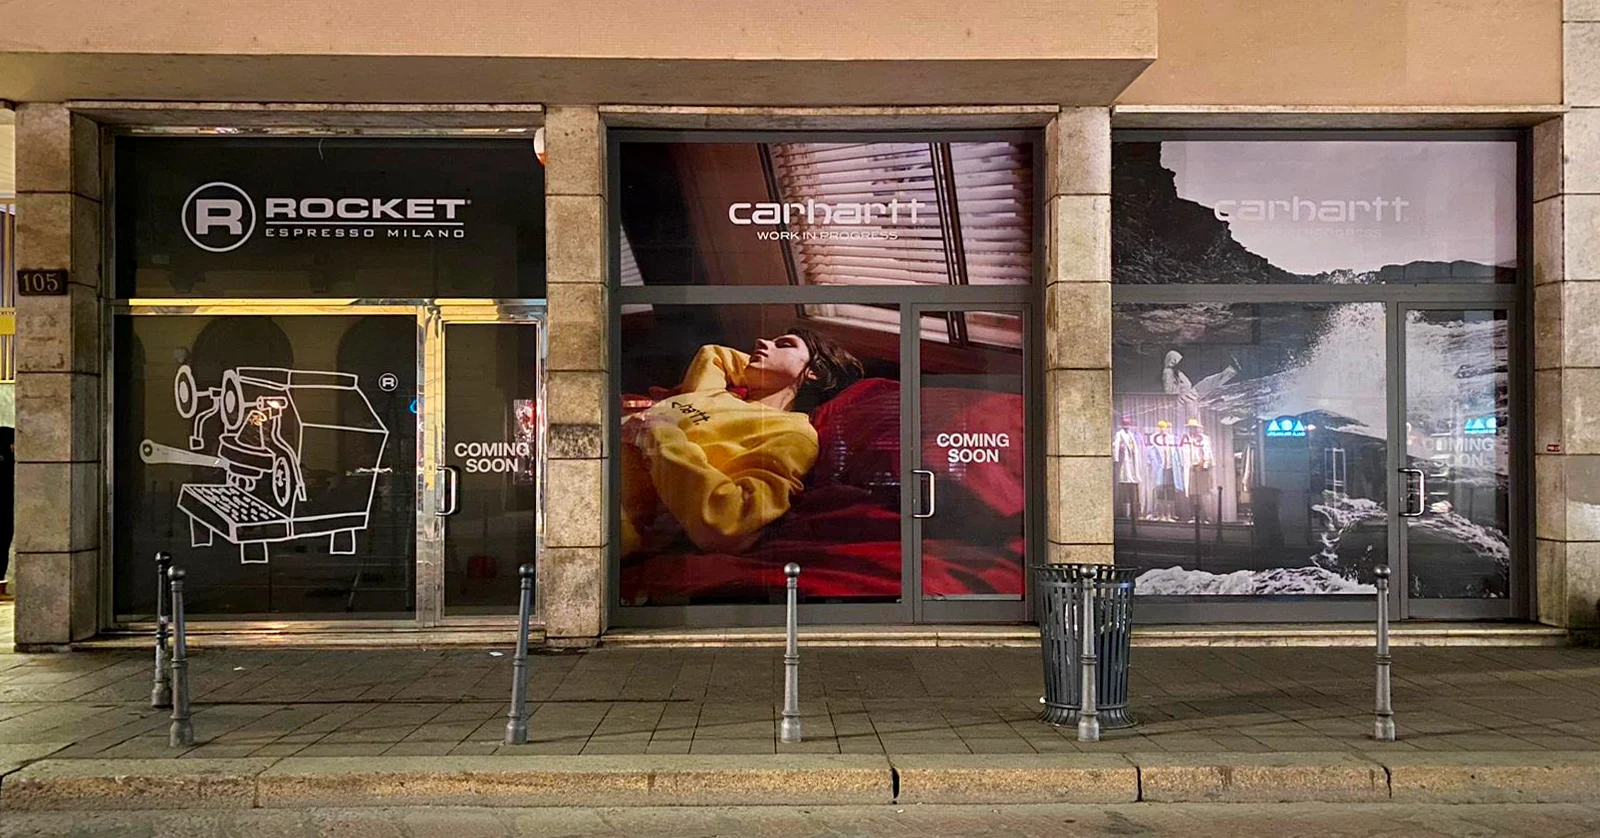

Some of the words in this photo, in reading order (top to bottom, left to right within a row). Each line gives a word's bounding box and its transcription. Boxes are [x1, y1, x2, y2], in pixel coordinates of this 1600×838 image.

[265, 197, 466, 219] ROCKET
[728, 198, 926, 225] carhartt
[1214, 195, 1410, 222] carhartt
[265, 228, 375, 238] ESPRESSO
[387, 228, 465, 239] MILANO
[756, 231, 800, 241] WORK
[802, 231, 817, 241] IN
[819, 231, 899, 241] PROGRESS
[23, 272, 59, 293] 105
[936, 432, 1010, 448] COMING
[454, 442, 530, 457] COMING
[947, 448, 1000, 463] SOON
[465, 458, 519, 473] SOON
